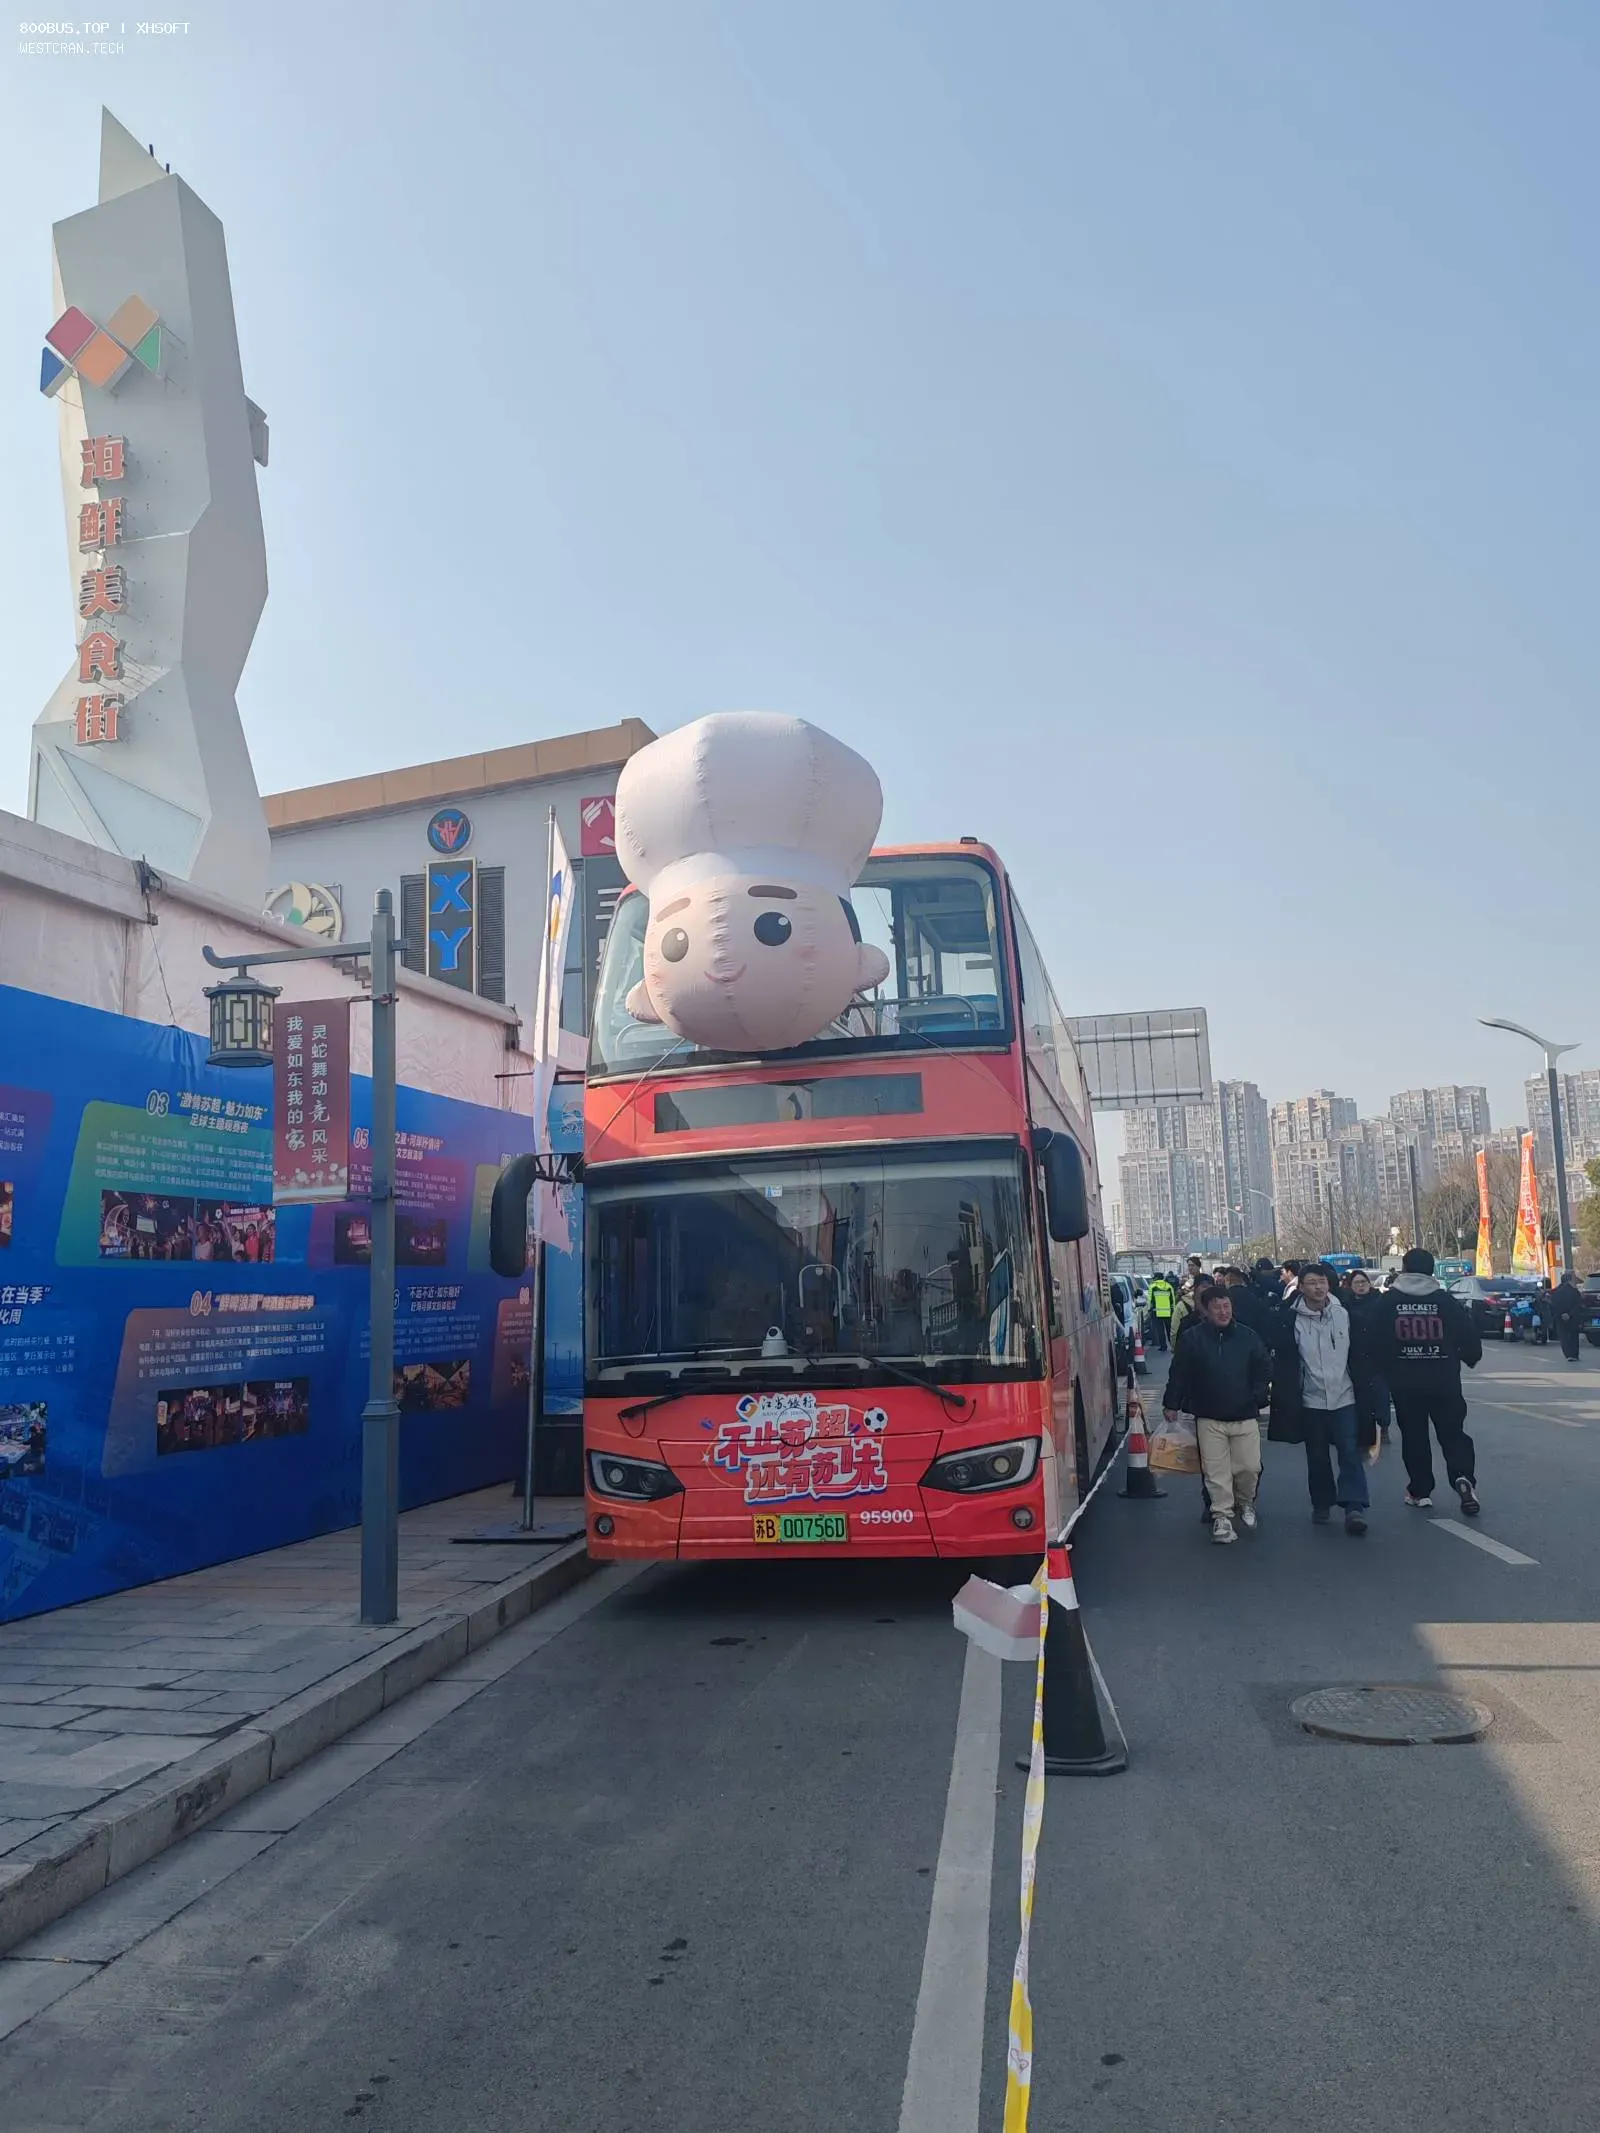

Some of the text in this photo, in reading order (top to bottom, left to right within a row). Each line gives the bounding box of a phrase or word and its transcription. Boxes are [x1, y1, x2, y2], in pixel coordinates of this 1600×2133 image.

[74, 434, 129, 746] 海鲜美食街
[146, 1089, 169, 1118] 03
[285, 1015, 306, 1151] 我爱如东我的家
[308, 1024, 330, 1164] 灵蛇舞动竞风采
[353, 1127, 370, 1150] 05
[190, 1290, 212, 1317] 04
[718, 1408, 850, 1468] 不止苏超
[748, 1443, 886, 1500] 还有苏味
[859, 1509, 914, 1524] 95900
